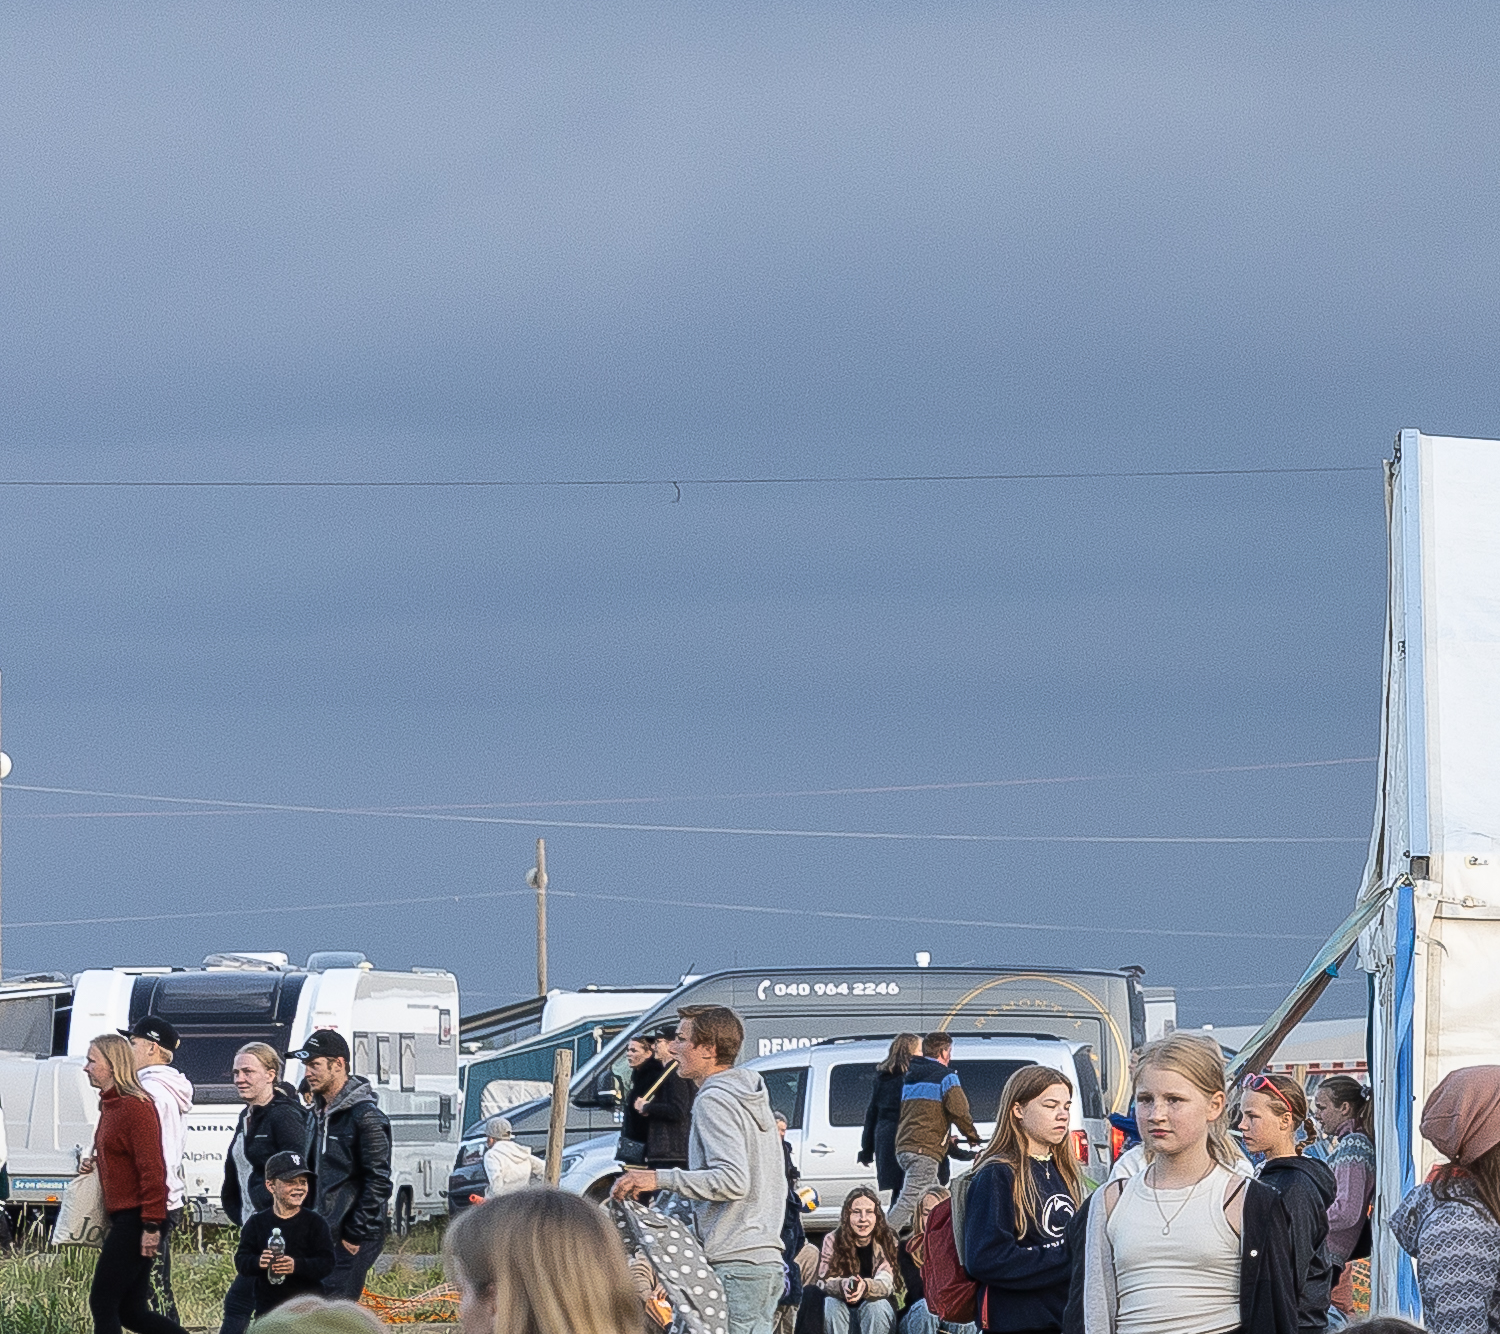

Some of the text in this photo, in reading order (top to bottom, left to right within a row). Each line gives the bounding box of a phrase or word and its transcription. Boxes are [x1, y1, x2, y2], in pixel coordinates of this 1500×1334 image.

[774, 982, 900, 996] 040 964 2246
[181, 1151, 222, 1163] Alpina
